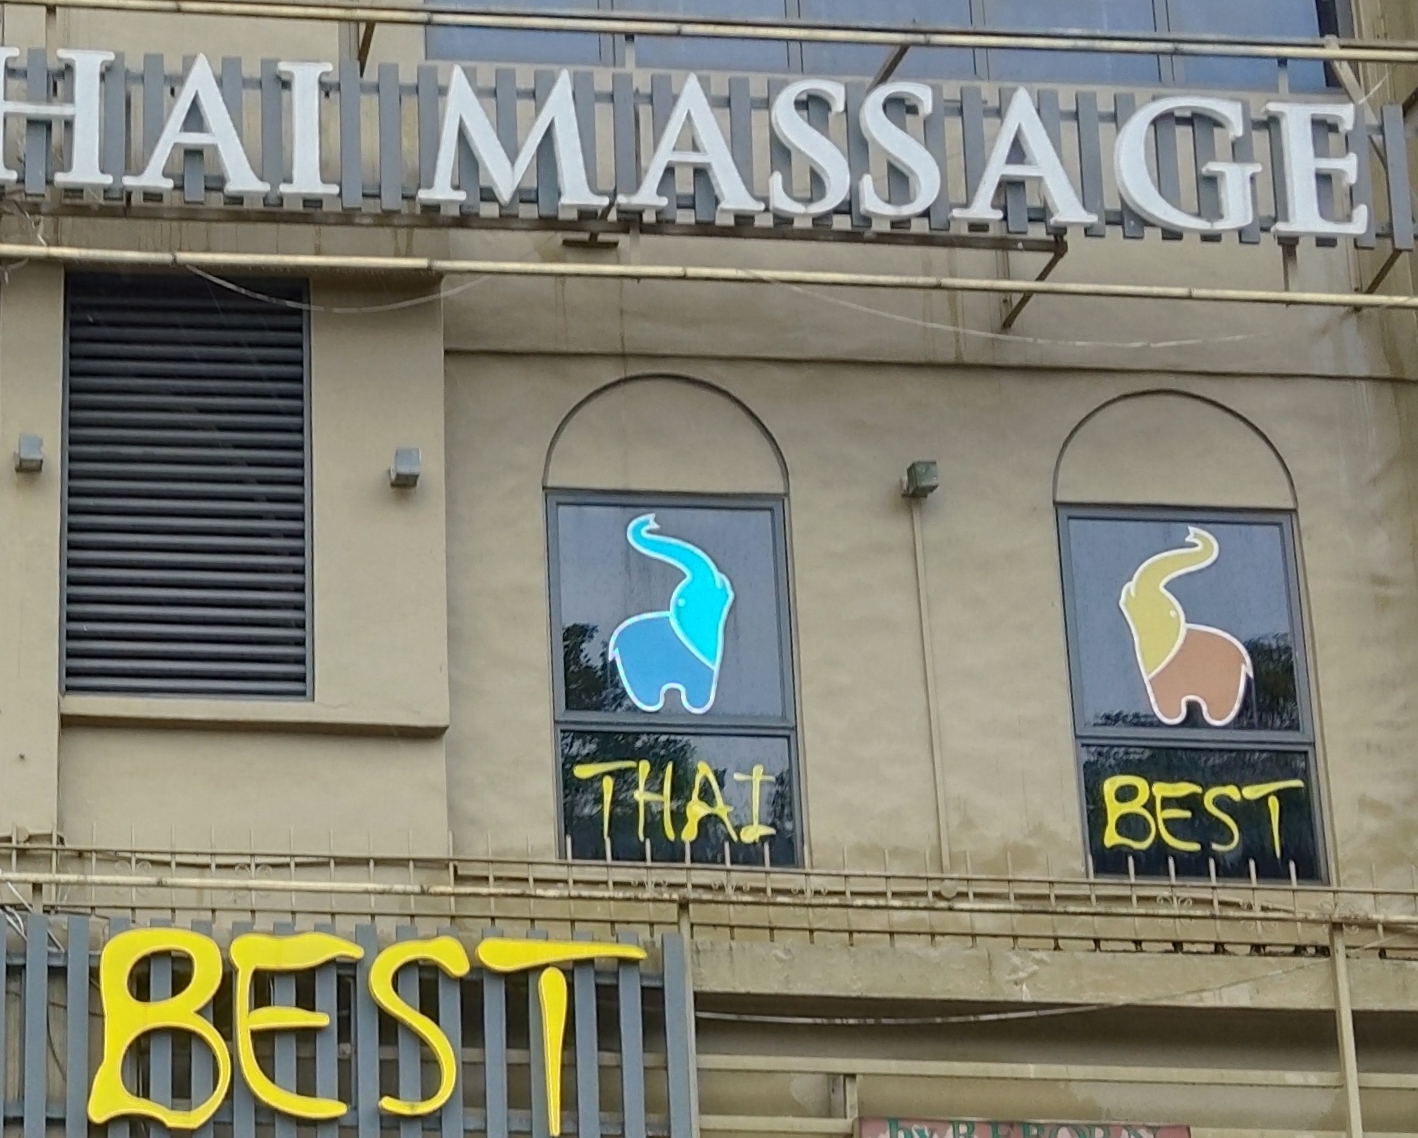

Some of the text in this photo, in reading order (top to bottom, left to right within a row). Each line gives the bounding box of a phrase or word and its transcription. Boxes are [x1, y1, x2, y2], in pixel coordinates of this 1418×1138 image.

[417, 63, 1370, 238] MASSAGE
[572, 759, 1305, 860] THAI BEST
[87, 927, 648, 1138] BEST
